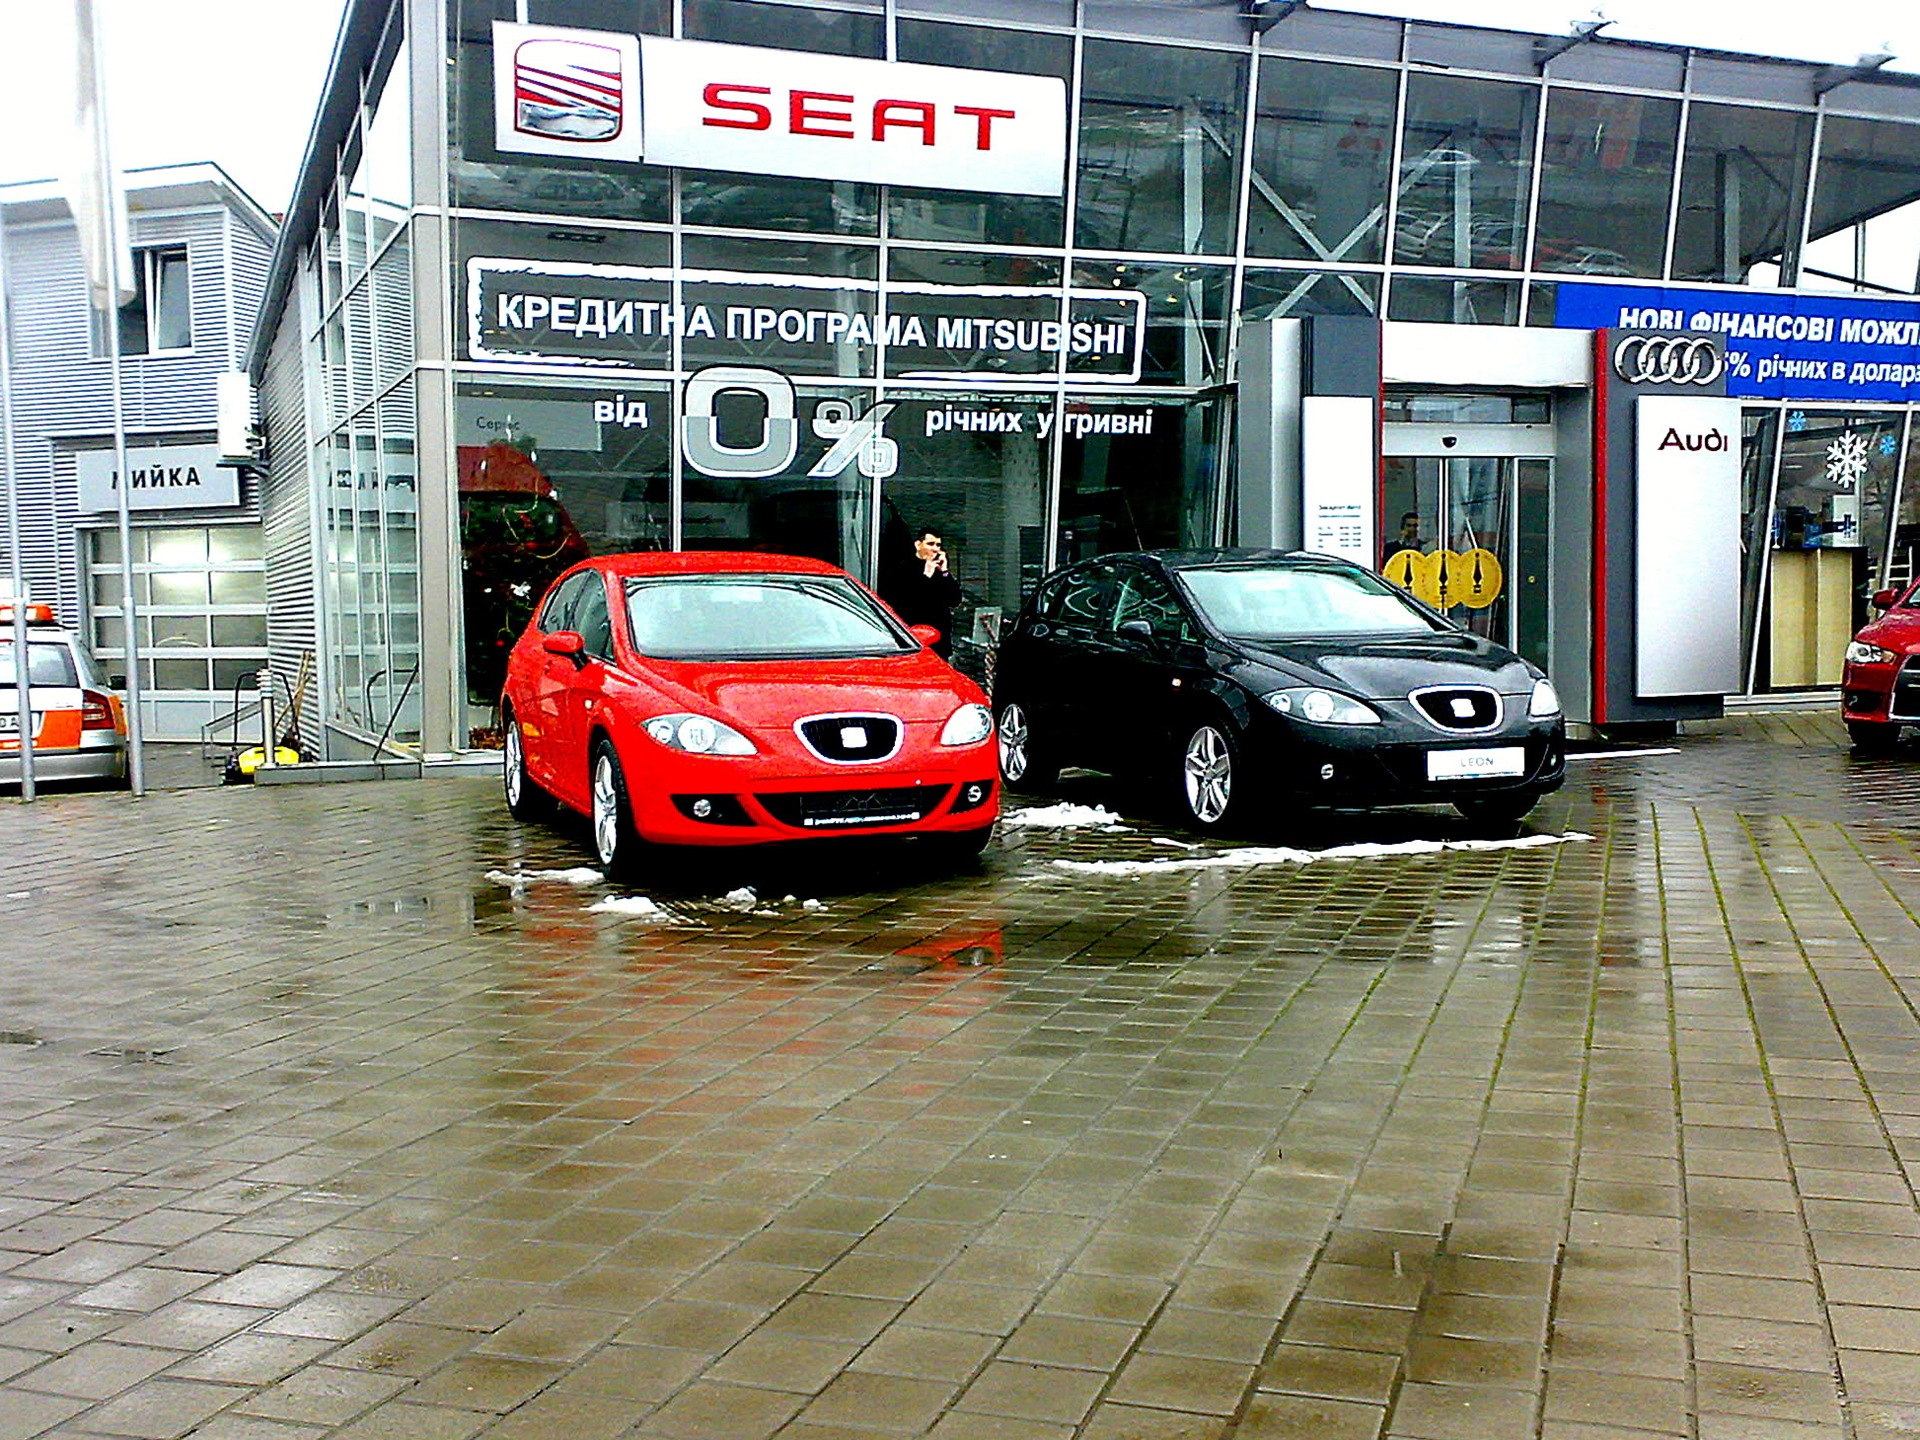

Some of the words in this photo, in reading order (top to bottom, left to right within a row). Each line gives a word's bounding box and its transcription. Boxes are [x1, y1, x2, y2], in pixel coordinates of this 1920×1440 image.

[702, 83, 1015, 151] SEAT
[497, 293, 716, 339] КРЕДИТНА
[726, 306, 927, 348] ПРОГРАМА
[936, 318, 1126, 355] MITSUBISHI
[1619, 308, 1683, 330] НОВІ
[1690, 312, 1834, 343] ФІНАНСОВІ
[1839, 318, 1920, 347] МОЖЛ
[1757, 353, 1827, 383] річних
[1832, 361, 1846, 381] в
[476, 416, 520, 432] Серс
[594, 394, 648, 429] від
[680, 362, 900, 479] 0%
[926, 404, 1023, 437] річних
[1036, 412, 1055, 439] у
[1064, 408, 1154, 440] гривні
[1657, 427, 1728, 452] Audi
[1461, 757, 1494, 768] LEON
